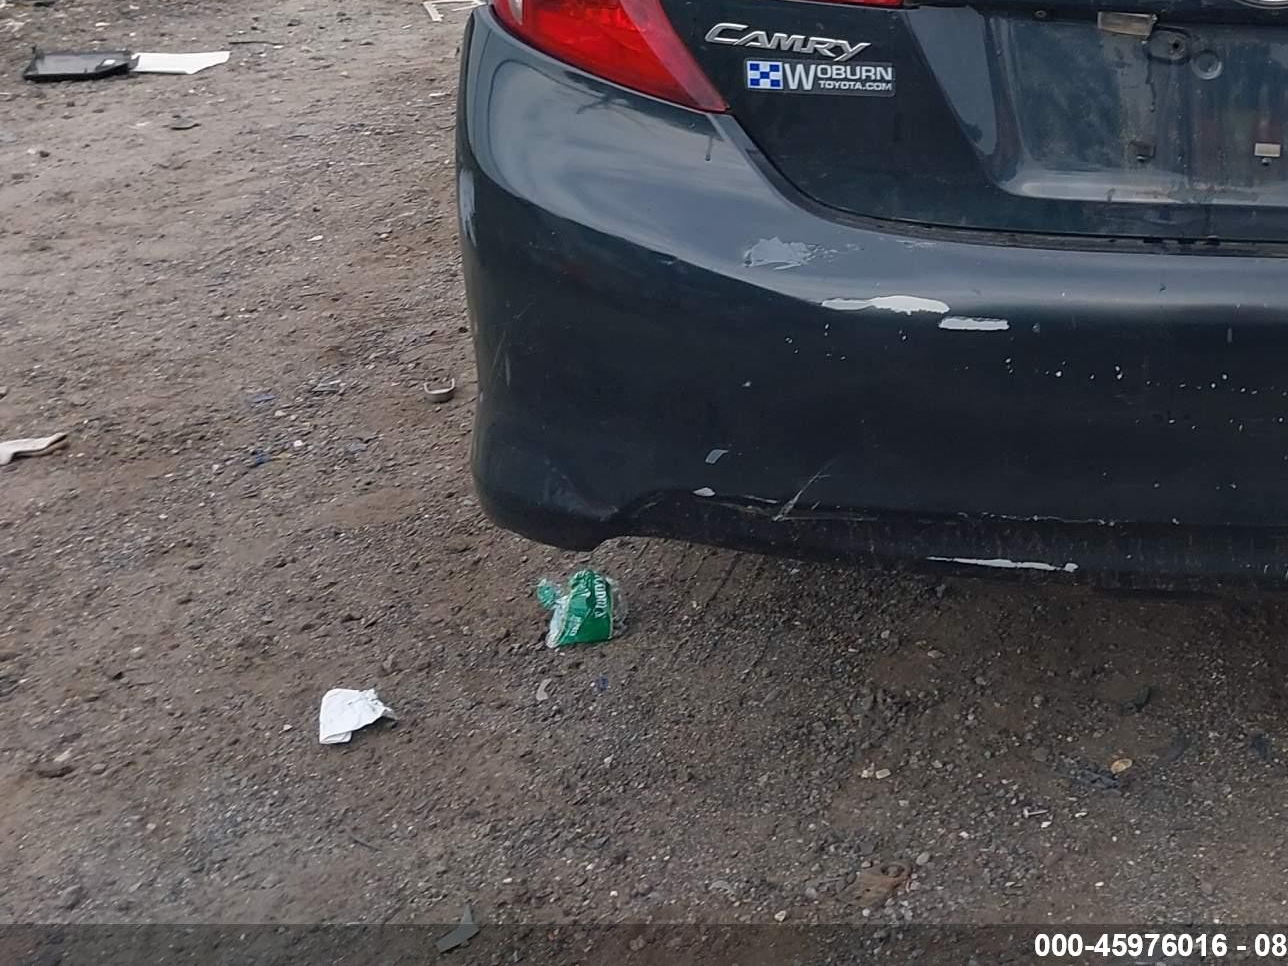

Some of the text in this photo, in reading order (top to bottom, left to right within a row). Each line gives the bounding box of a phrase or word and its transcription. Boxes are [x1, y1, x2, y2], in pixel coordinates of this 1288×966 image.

[704, 22, 871, 62] CAMRY
[783, 62, 893, 91] WOBURN
[817, 79, 893, 91] TOYOTA.COM
